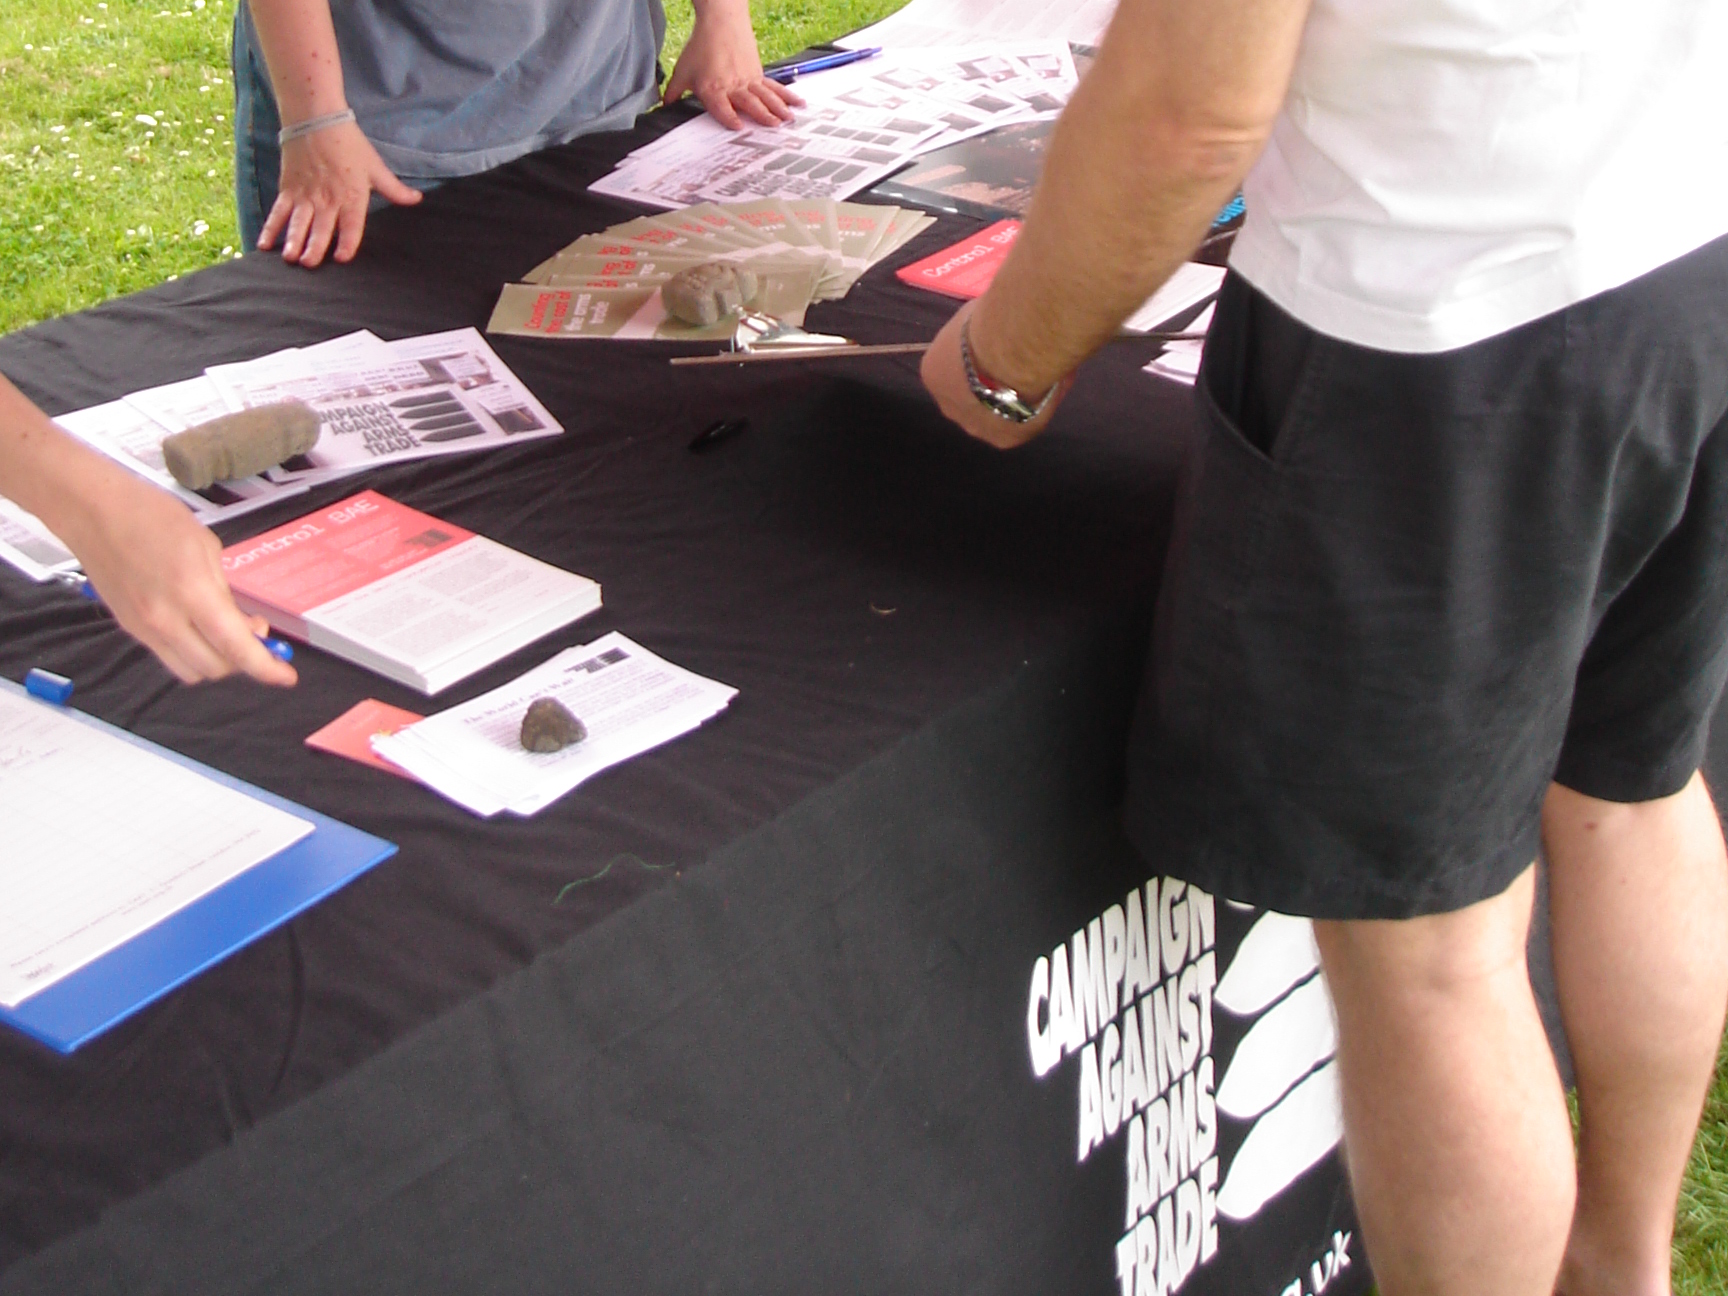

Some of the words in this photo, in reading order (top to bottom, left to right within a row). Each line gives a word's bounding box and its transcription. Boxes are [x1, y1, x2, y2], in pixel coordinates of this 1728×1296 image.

[922, 245, 995, 278] Control
[329, 412, 400, 437] AGAINST
[362, 423, 410, 444] ARMS
[362, 435, 422, 457] TRADE
[221, 523, 326, 573] Control
[327, 498, 380, 527] BAE
[1027, 875, 1216, 1078] CAMPAIGN
[1077, 950, 1217, 1164] AGAINST
[1125, 1055, 1219, 1231] ARMS
[1115, 1156, 1220, 1296] TRADE
